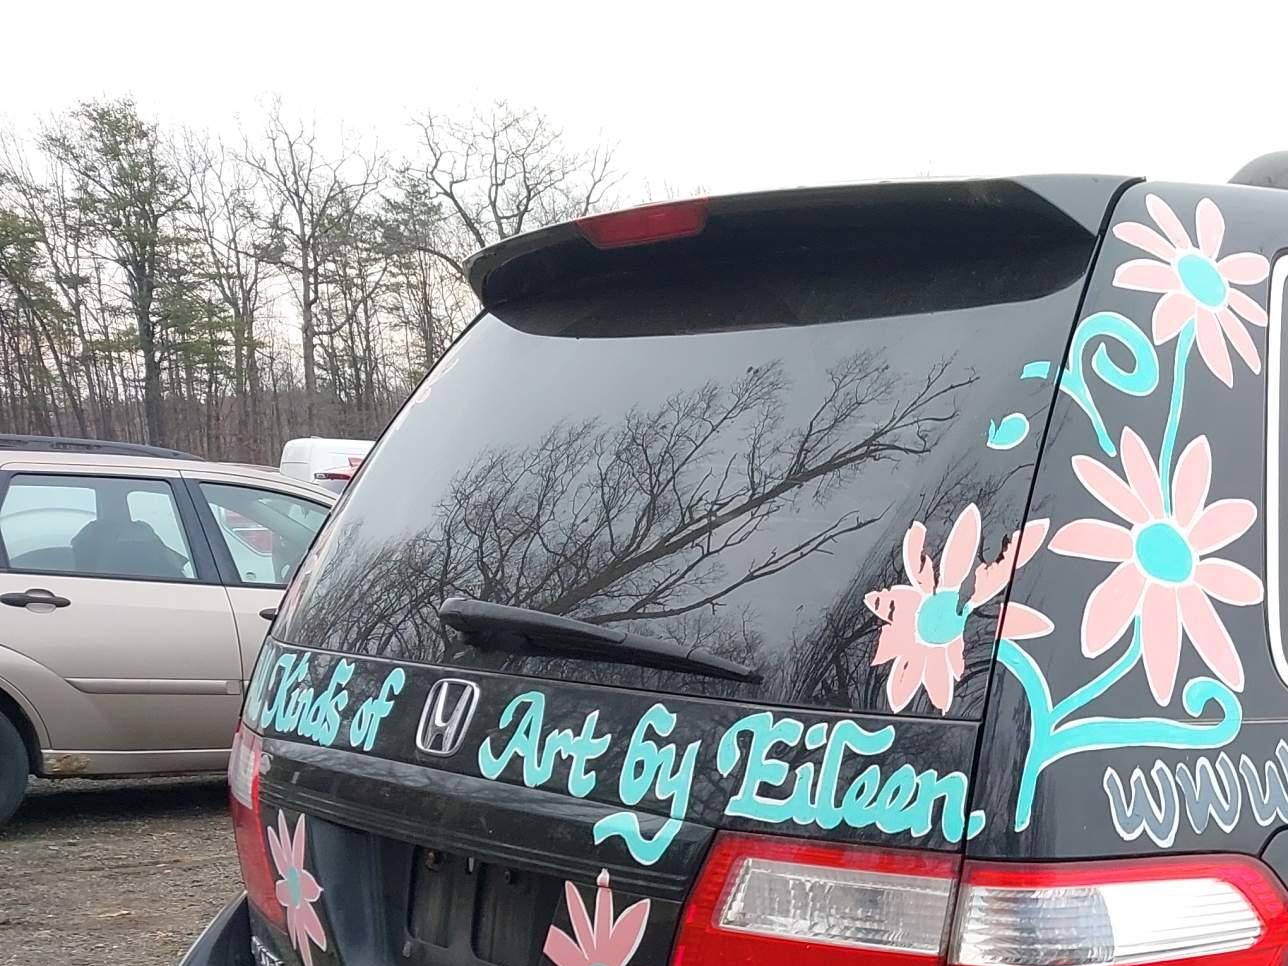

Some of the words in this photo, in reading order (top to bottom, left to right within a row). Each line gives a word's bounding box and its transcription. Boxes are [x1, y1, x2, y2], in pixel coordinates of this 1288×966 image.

[261, 651, 356, 747] Kinds
[349, 665, 406, 753] of
[477, 690, 612, 798] Art
[593, 703, 703, 866] by
